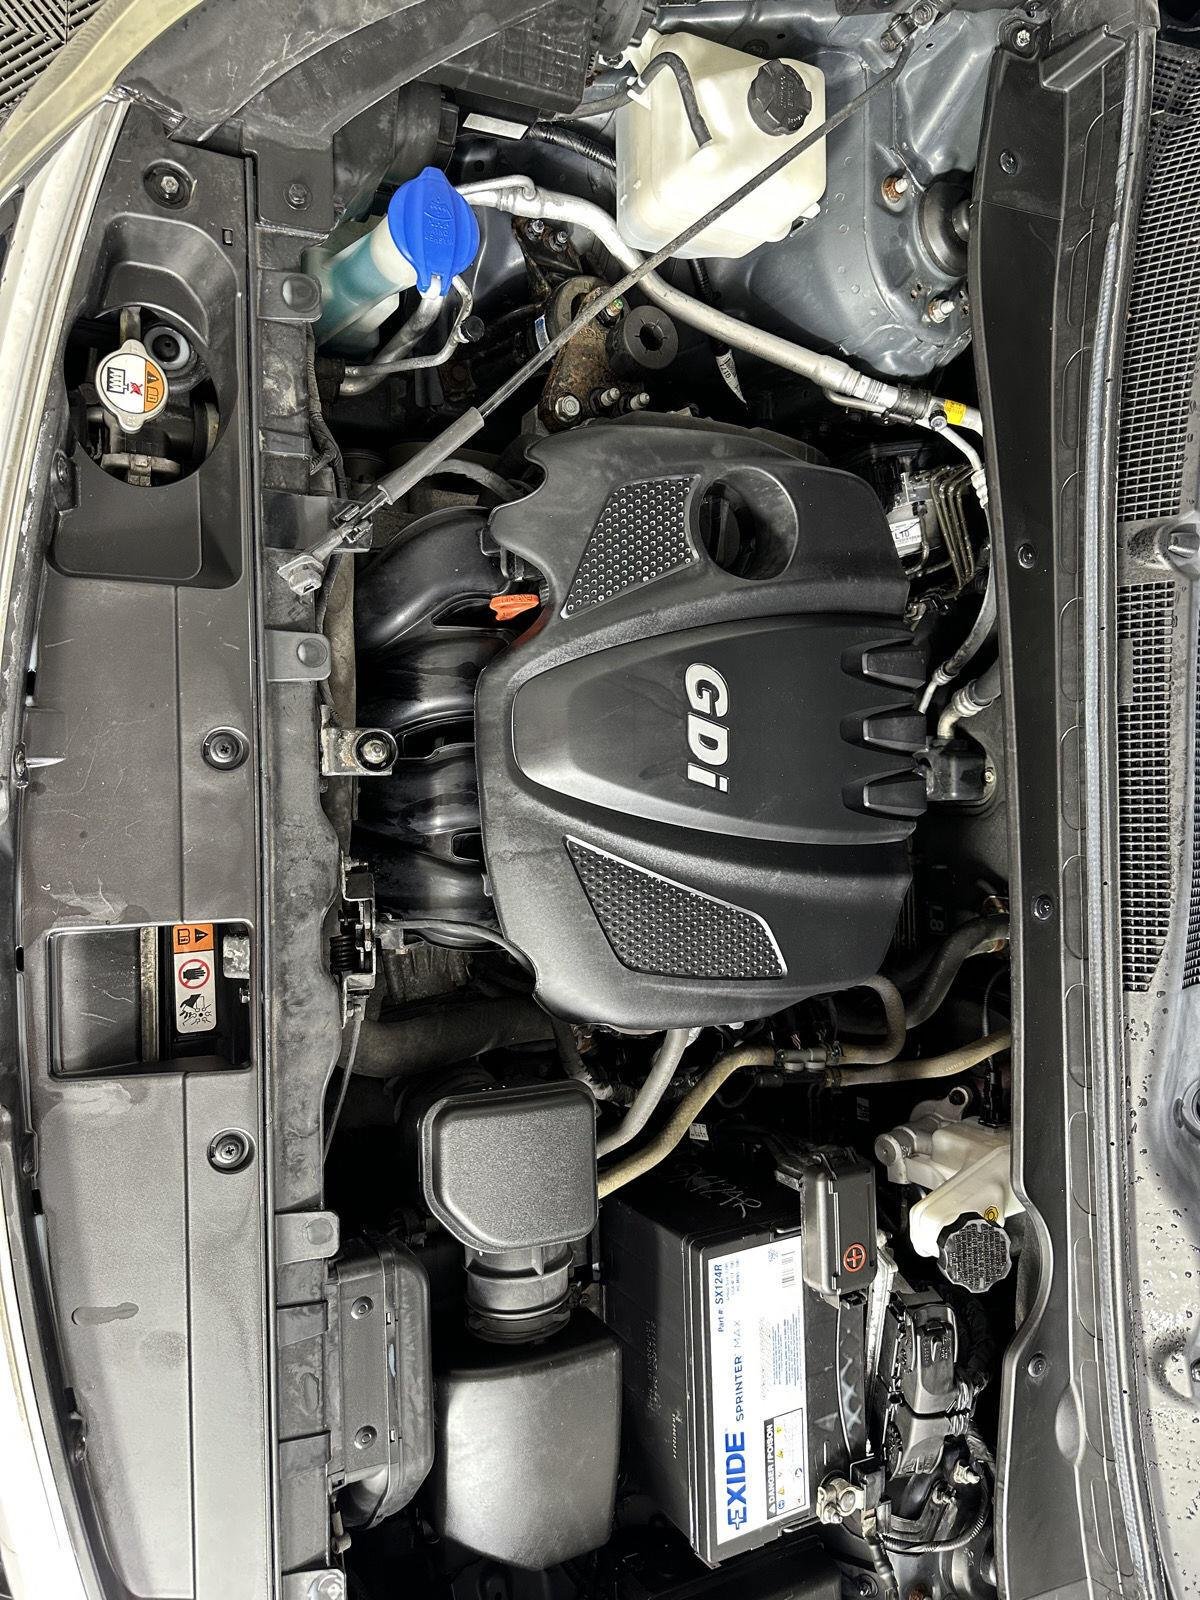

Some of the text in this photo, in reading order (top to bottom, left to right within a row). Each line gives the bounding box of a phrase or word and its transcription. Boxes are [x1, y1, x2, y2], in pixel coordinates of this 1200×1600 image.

[685, 662, 730, 794] GDi
[714, 1264, 724, 1304] SX124R
[717, 1316, 725, 1332] Part
[725, 1320, 747, 1530] EXIDE SPRINTER MAX
